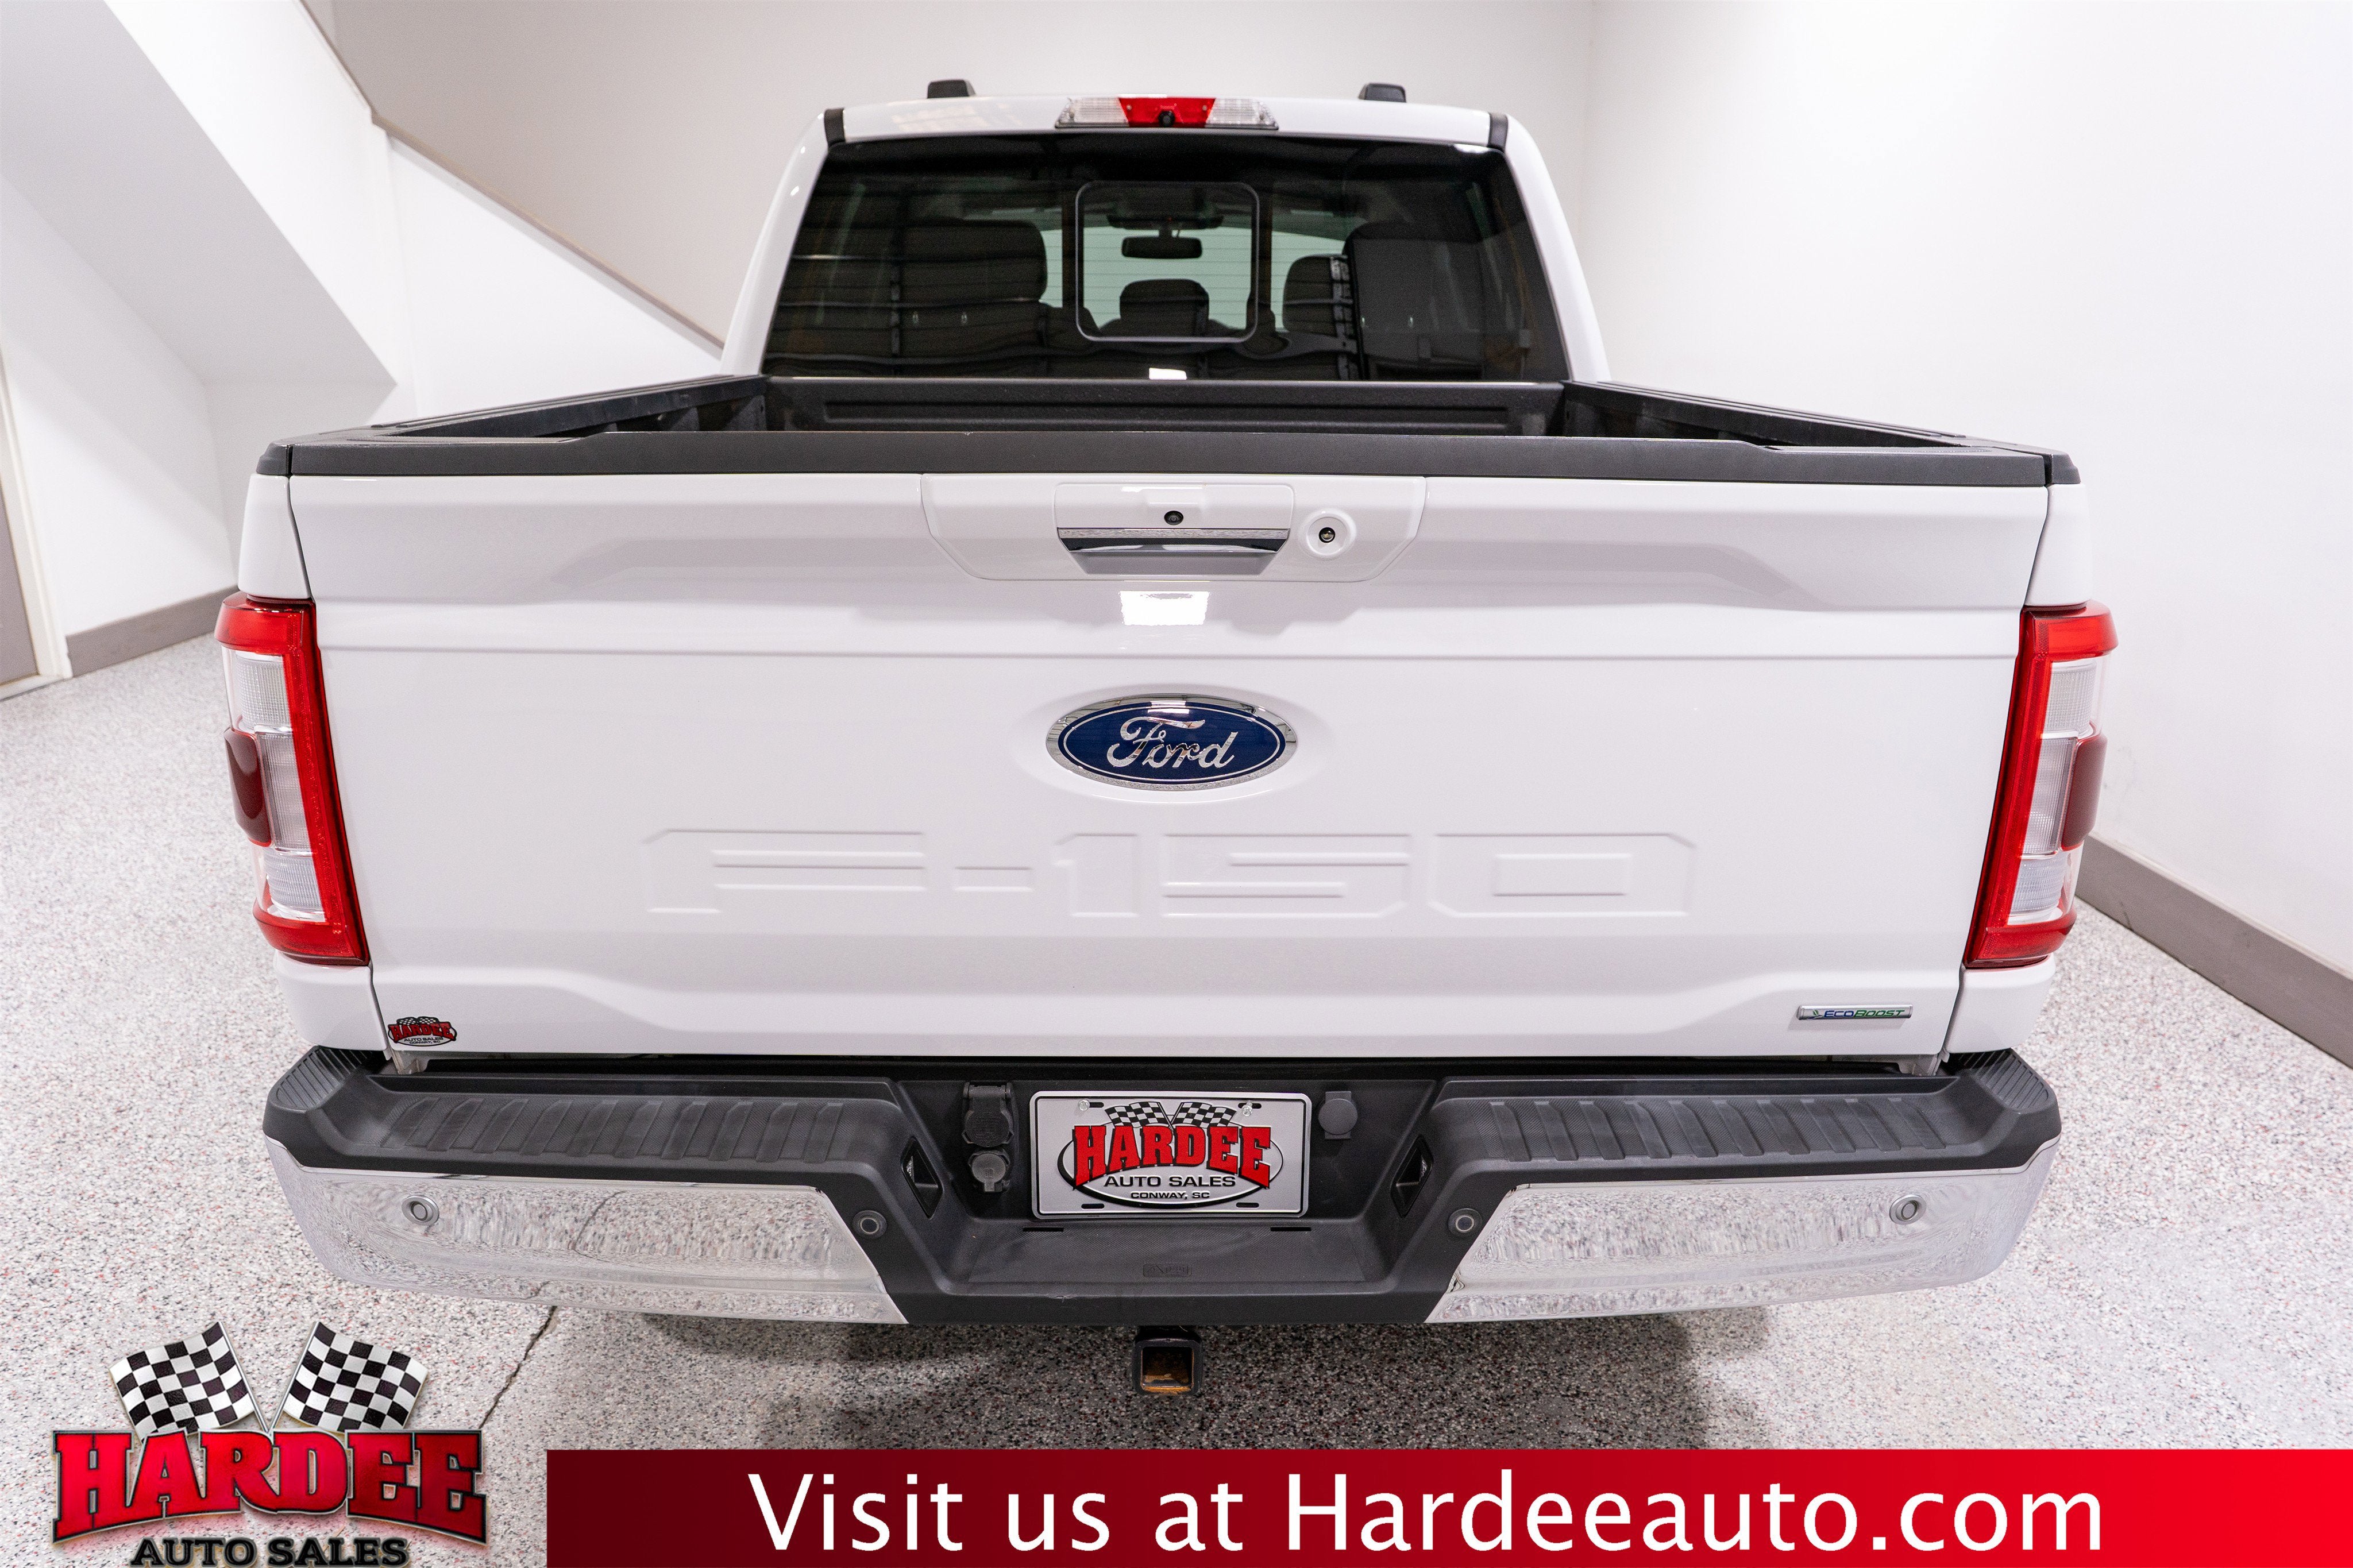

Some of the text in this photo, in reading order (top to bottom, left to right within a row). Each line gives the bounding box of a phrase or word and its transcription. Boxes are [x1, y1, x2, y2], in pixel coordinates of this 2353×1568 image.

[1106, 716, 1239, 768] Ford
[643, 829, 1697, 919] F-150
[388, 1022, 455, 1042] HARDEE
[1073, 1125, 1271, 1188] HARDEE
[1104, 1176, 1236, 1187] AUTO SALES
